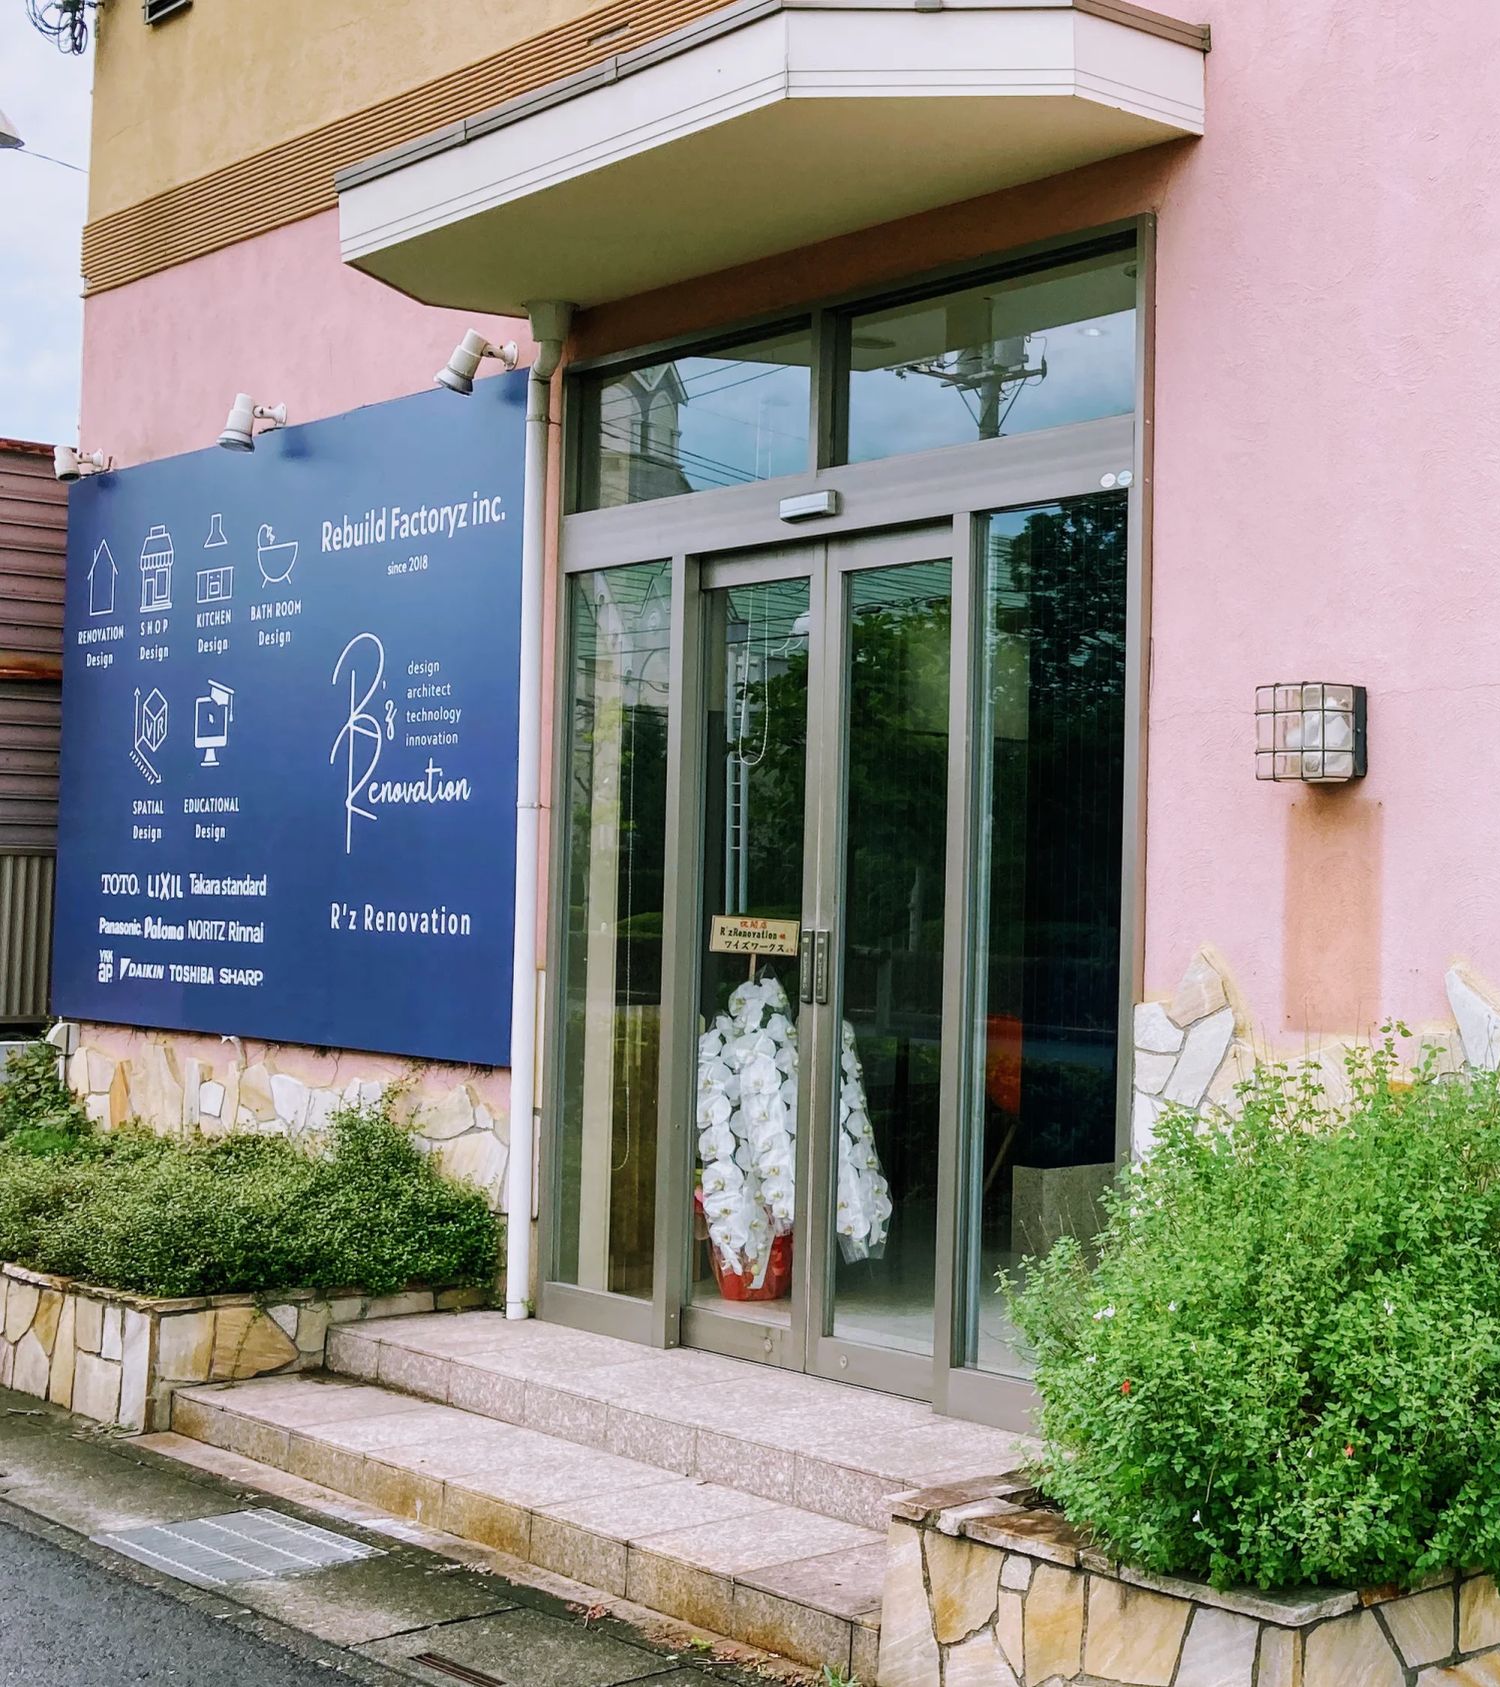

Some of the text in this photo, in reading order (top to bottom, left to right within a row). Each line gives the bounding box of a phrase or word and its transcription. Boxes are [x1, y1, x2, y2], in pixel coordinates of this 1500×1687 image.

[321, 491, 506, 553] Rebuild Factoryz inc.
[387, 554, 428, 576] since 2018
[196, 609, 232, 628] KITCHEN
[250, 599, 302, 621] BATH ROOM
[77, 624, 124, 645] RENOVATION
[258, 628, 291, 648] Design
[139, 644, 169, 662] Design
[197, 636, 228, 655] Design
[86, 651, 114, 669] Design
[407, 659, 440, 677] design
[407, 682, 452, 699] architect
[406, 705, 462, 724] technology
[405, 731, 459, 747] innovation
[132, 799, 165, 815] SPATIAL
[183, 796, 240, 814] EDUCATIONAL
[132, 824, 162, 843] Design
[195, 823, 226, 842] Design
[147, 871, 184, 901] LIXIL
[221, 873, 268, 897] standard
[98, 916, 143, 937] Panasonic
[364, 903, 471, 936] Renovation
[187, 919, 226, 942] NORITZ
[227, 920, 265, 944] Rinnai
[127, 960, 165, 980] DAIKIN
[168, 963, 215, 985] TOSHIBA
[218, 967, 264, 987] SHARP
